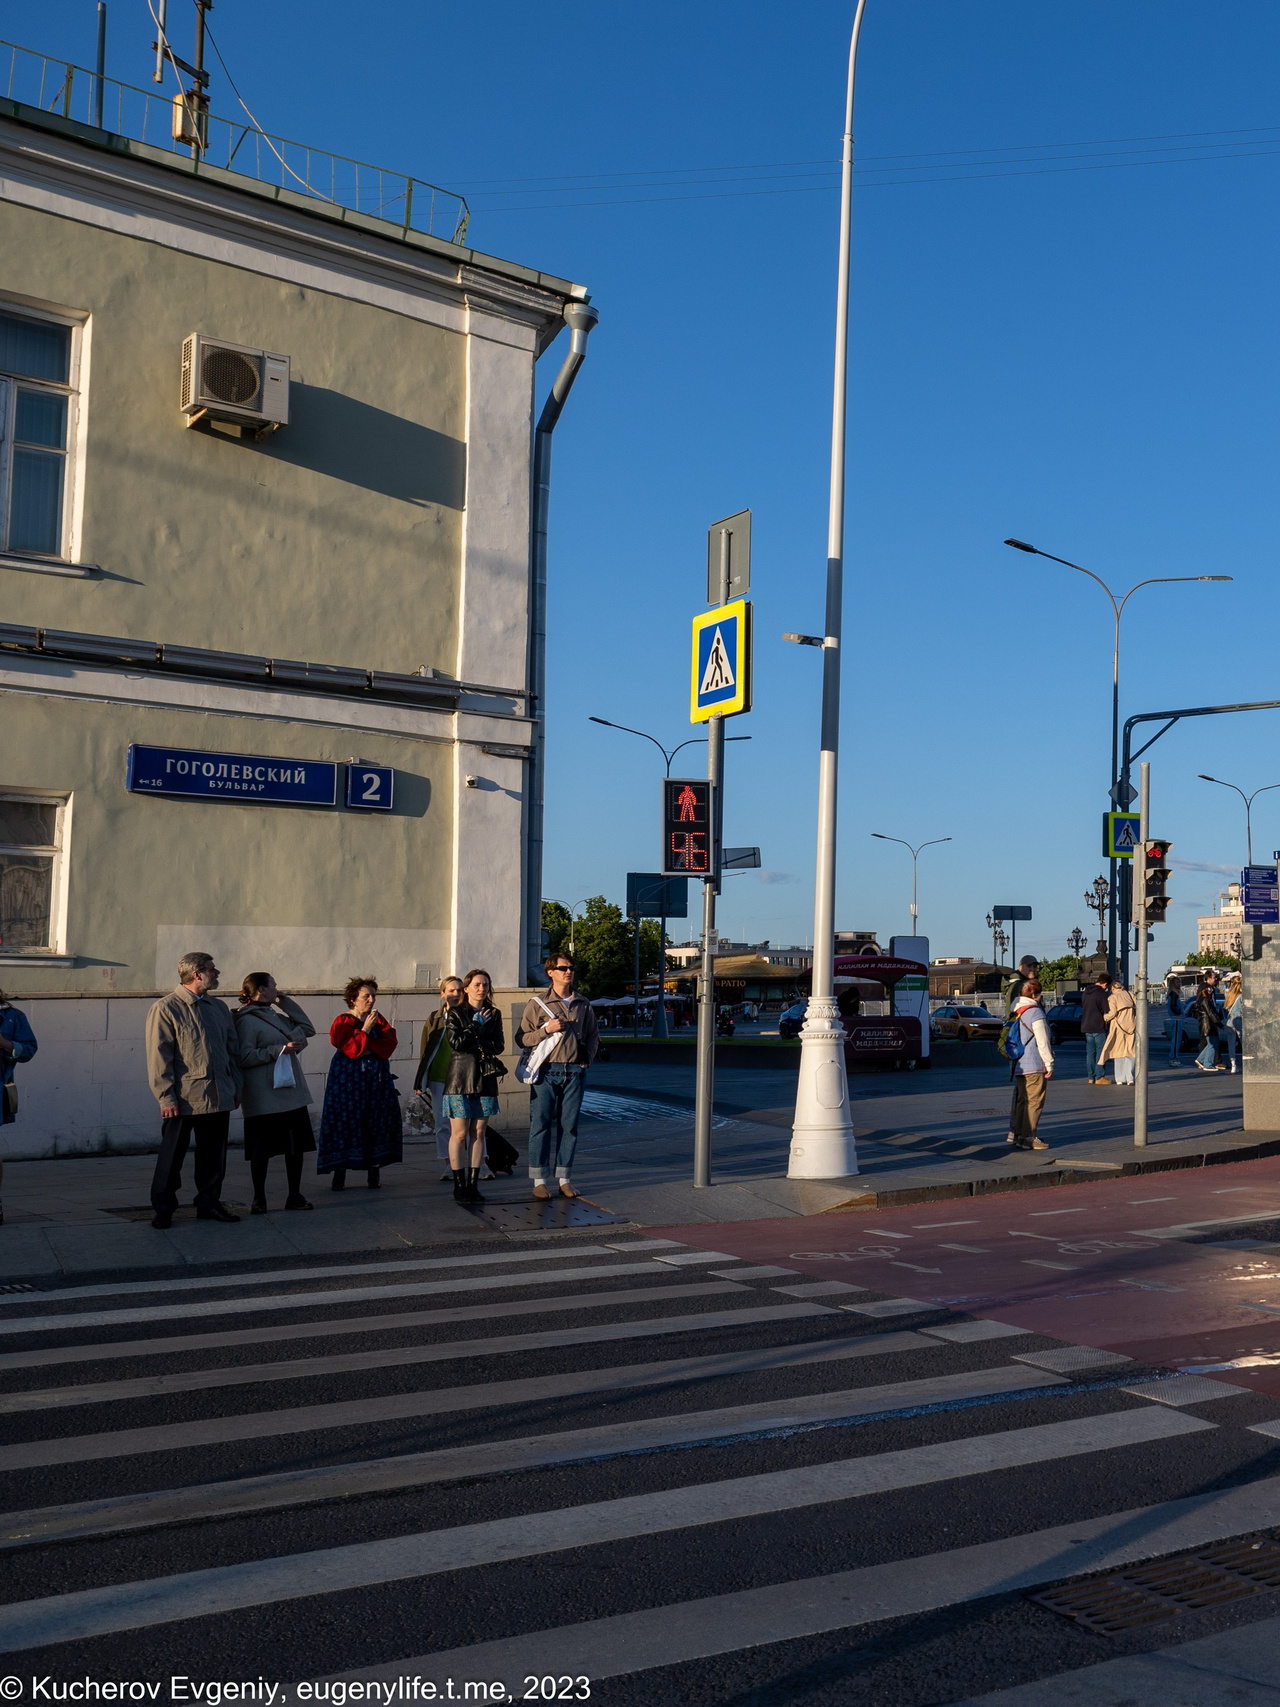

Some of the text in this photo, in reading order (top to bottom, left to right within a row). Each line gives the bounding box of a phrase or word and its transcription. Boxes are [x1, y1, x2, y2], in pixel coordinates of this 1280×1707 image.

[165, 758, 306, 785] ГОГОЛЕВСКИЙ
[151, 778, 163, 787] 16
[209, 780, 265, 792] БУЛЬВАР
[361, 773, 381, 801] 2
[721, 979, 747, 987] PATIO
